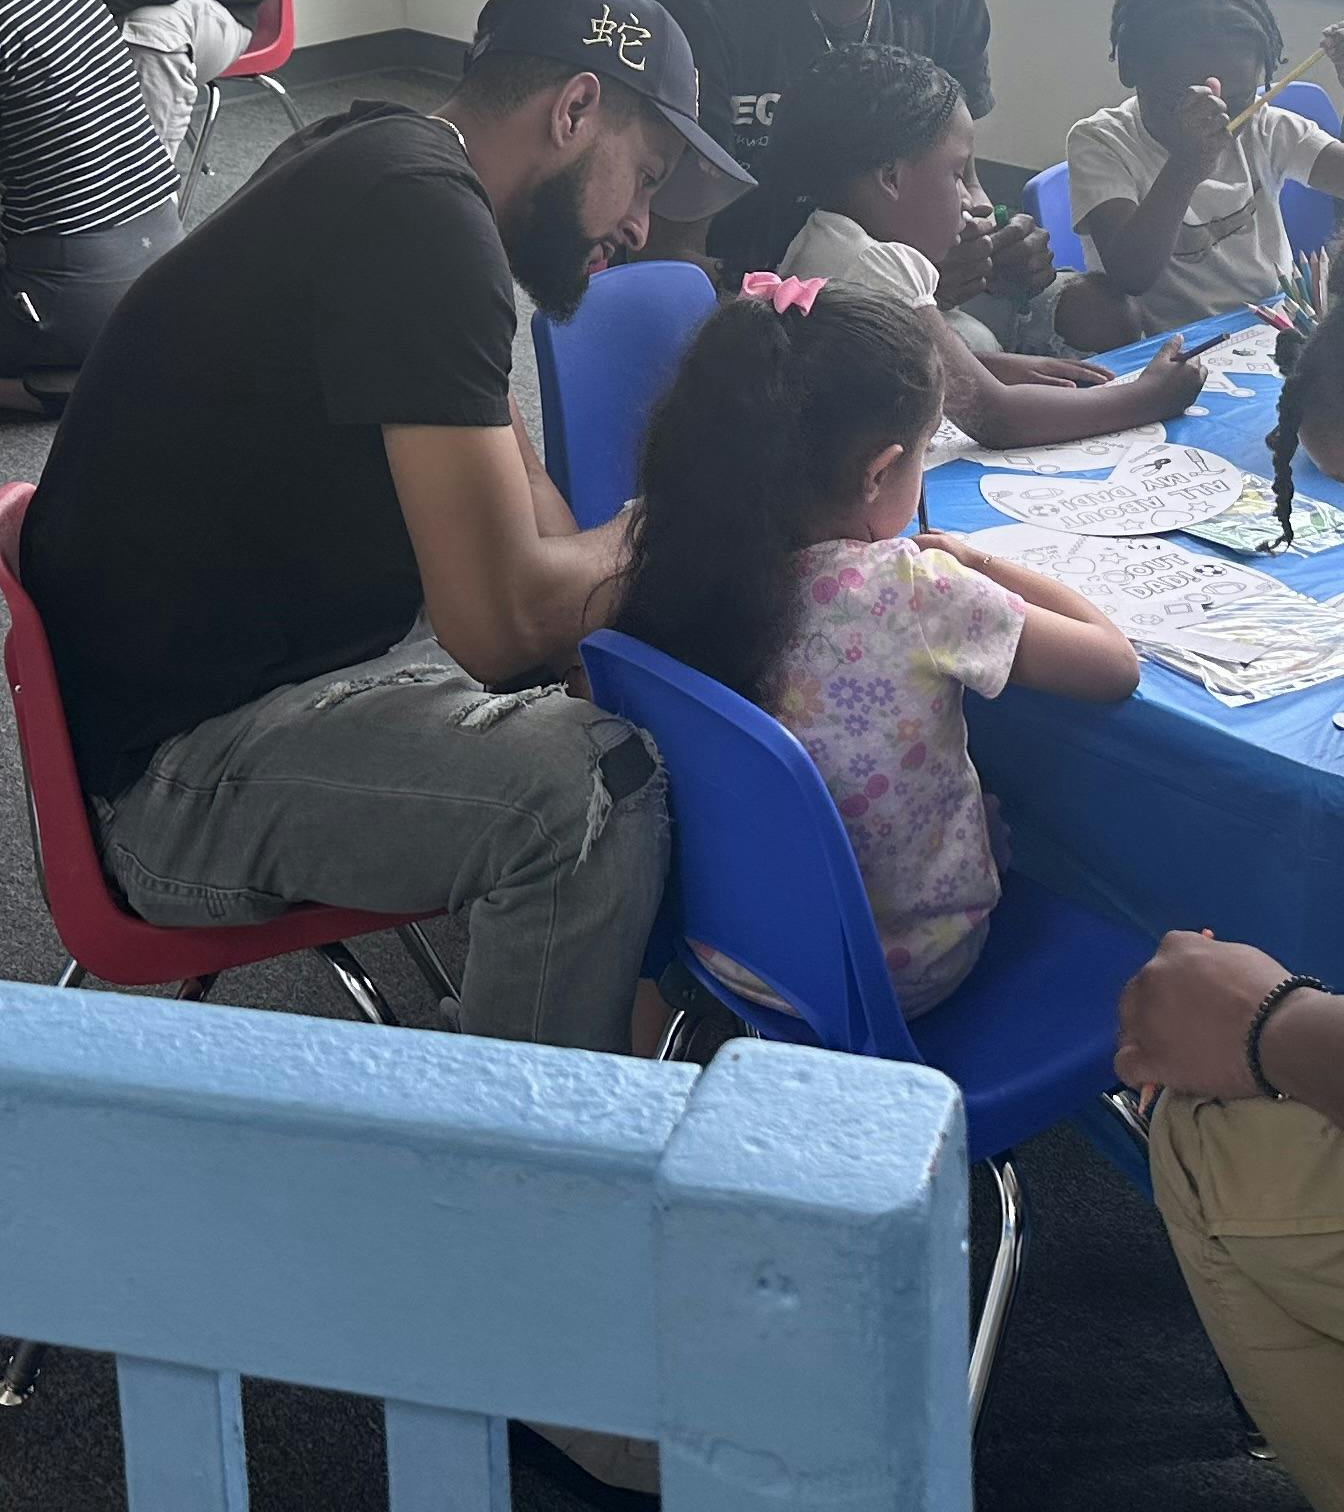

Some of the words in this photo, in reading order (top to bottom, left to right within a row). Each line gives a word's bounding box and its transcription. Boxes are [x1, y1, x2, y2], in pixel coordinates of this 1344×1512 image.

[582, 3, 653, 72] 蛇
[1142, 472, 1191, 491] MY
[1169, 479, 1230, 500] ALL
[1060, 485, 1138, 509] DAD!
[1060, 496, 1165, 529] ABOUT
[1122, 571, 1201, 599] DAD!
